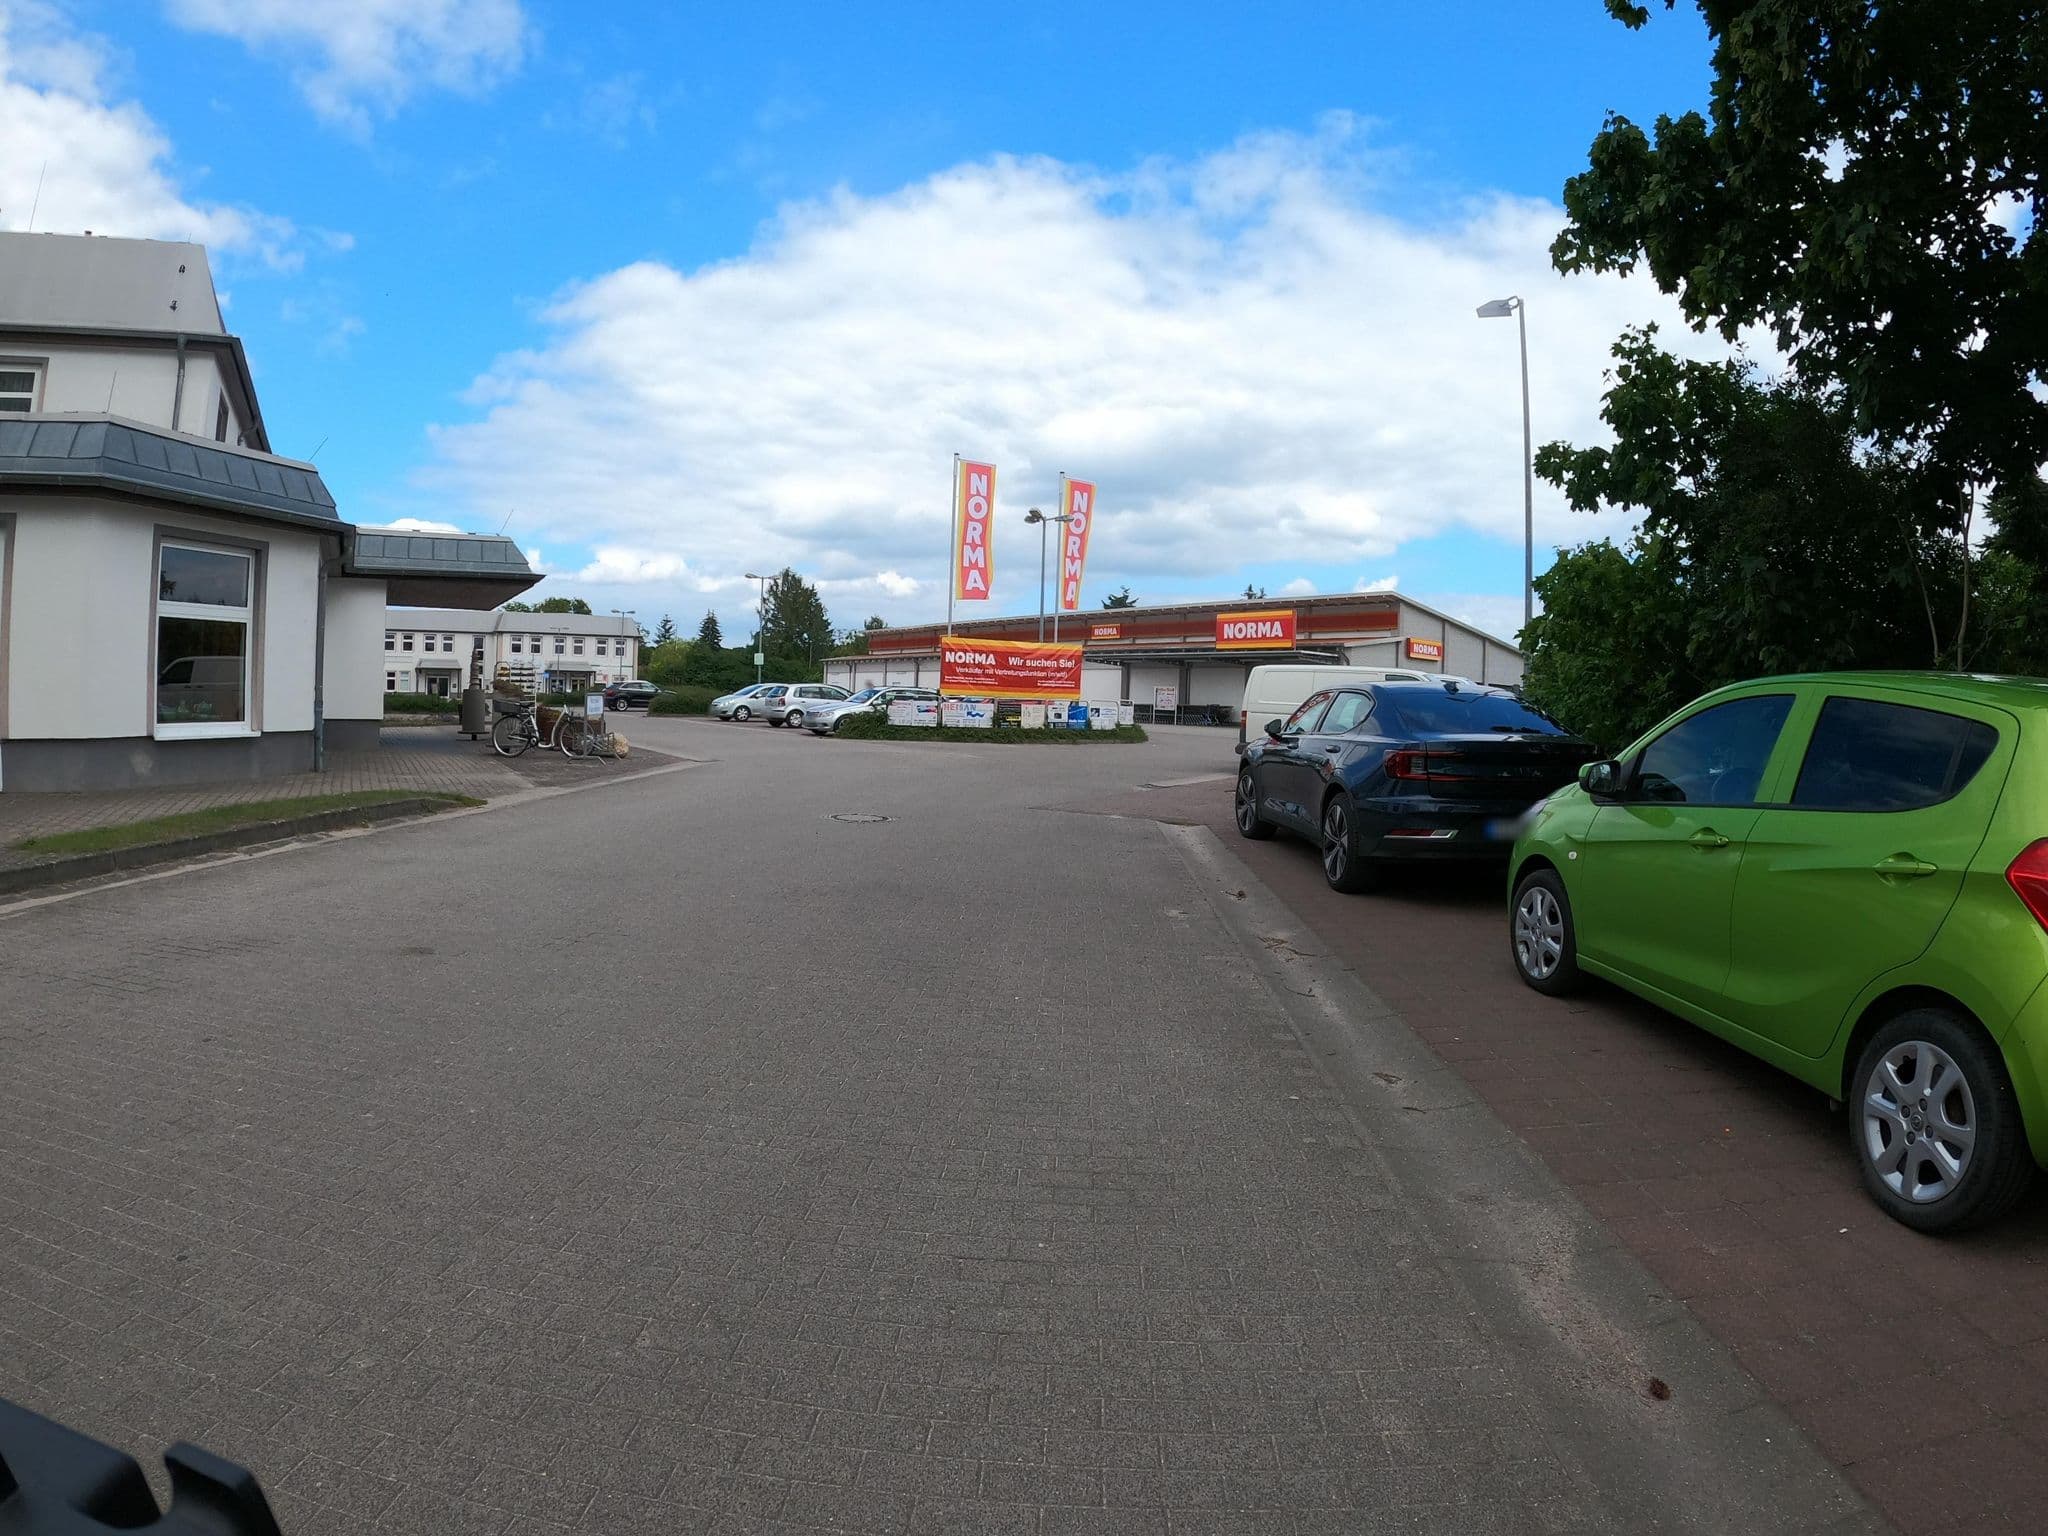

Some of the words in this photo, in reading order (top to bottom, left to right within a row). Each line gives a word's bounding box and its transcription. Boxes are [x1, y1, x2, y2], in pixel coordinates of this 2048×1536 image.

[963, 473, 988, 591] NORMA
[1065, 490, 1088, 601] NORMA
[1094, 627, 1117, 636] NORMA
[1223, 621, 1283, 639] NORMA
[1413, 643, 1438, 656] NORMA
[945, 651, 996, 666] NORMA
[1008, 656, 1025, 666] Wir
[1025, 658, 1057, 668] suchen
[1059, 659, 1075, 668] Sie!
